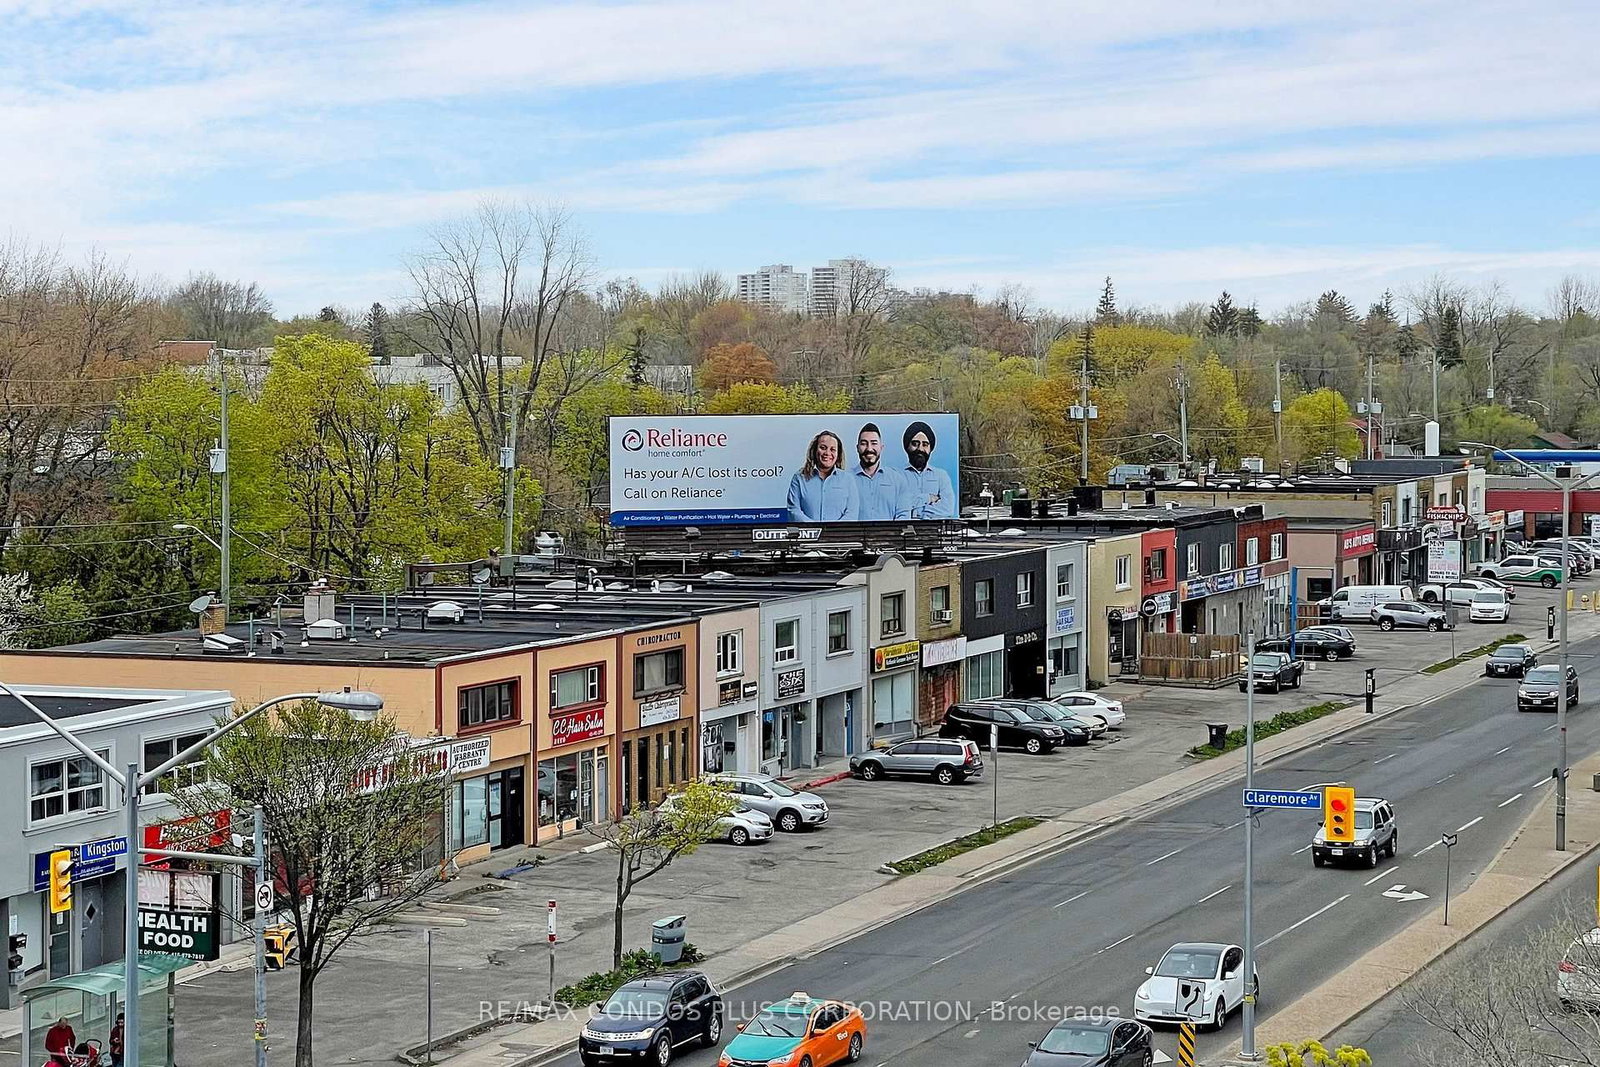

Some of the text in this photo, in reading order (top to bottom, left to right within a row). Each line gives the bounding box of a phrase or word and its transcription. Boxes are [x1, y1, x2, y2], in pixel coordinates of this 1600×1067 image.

[646, 428, 728, 448] Reliance
[648, 450, 670, 458] home
[624, 466, 784, 482] Has your A/C lost its cool?
[624, 487, 723, 499] Call on Reliance
[637, 632, 680, 646] CHIROPRACTOR
[566, 718, 584, 737] Hair
[585, 712, 603, 731] Salon
[453, 740, 488, 753] AUTHORIZED
[454, 749, 486, 762] WARRANTY
[458, 758, 482, 769] CENTRE
[1246, 792, 1307, 804] Claremore
[87, 840, 125, 856] Kingston
[144, 932, 194, 948] FOOD
